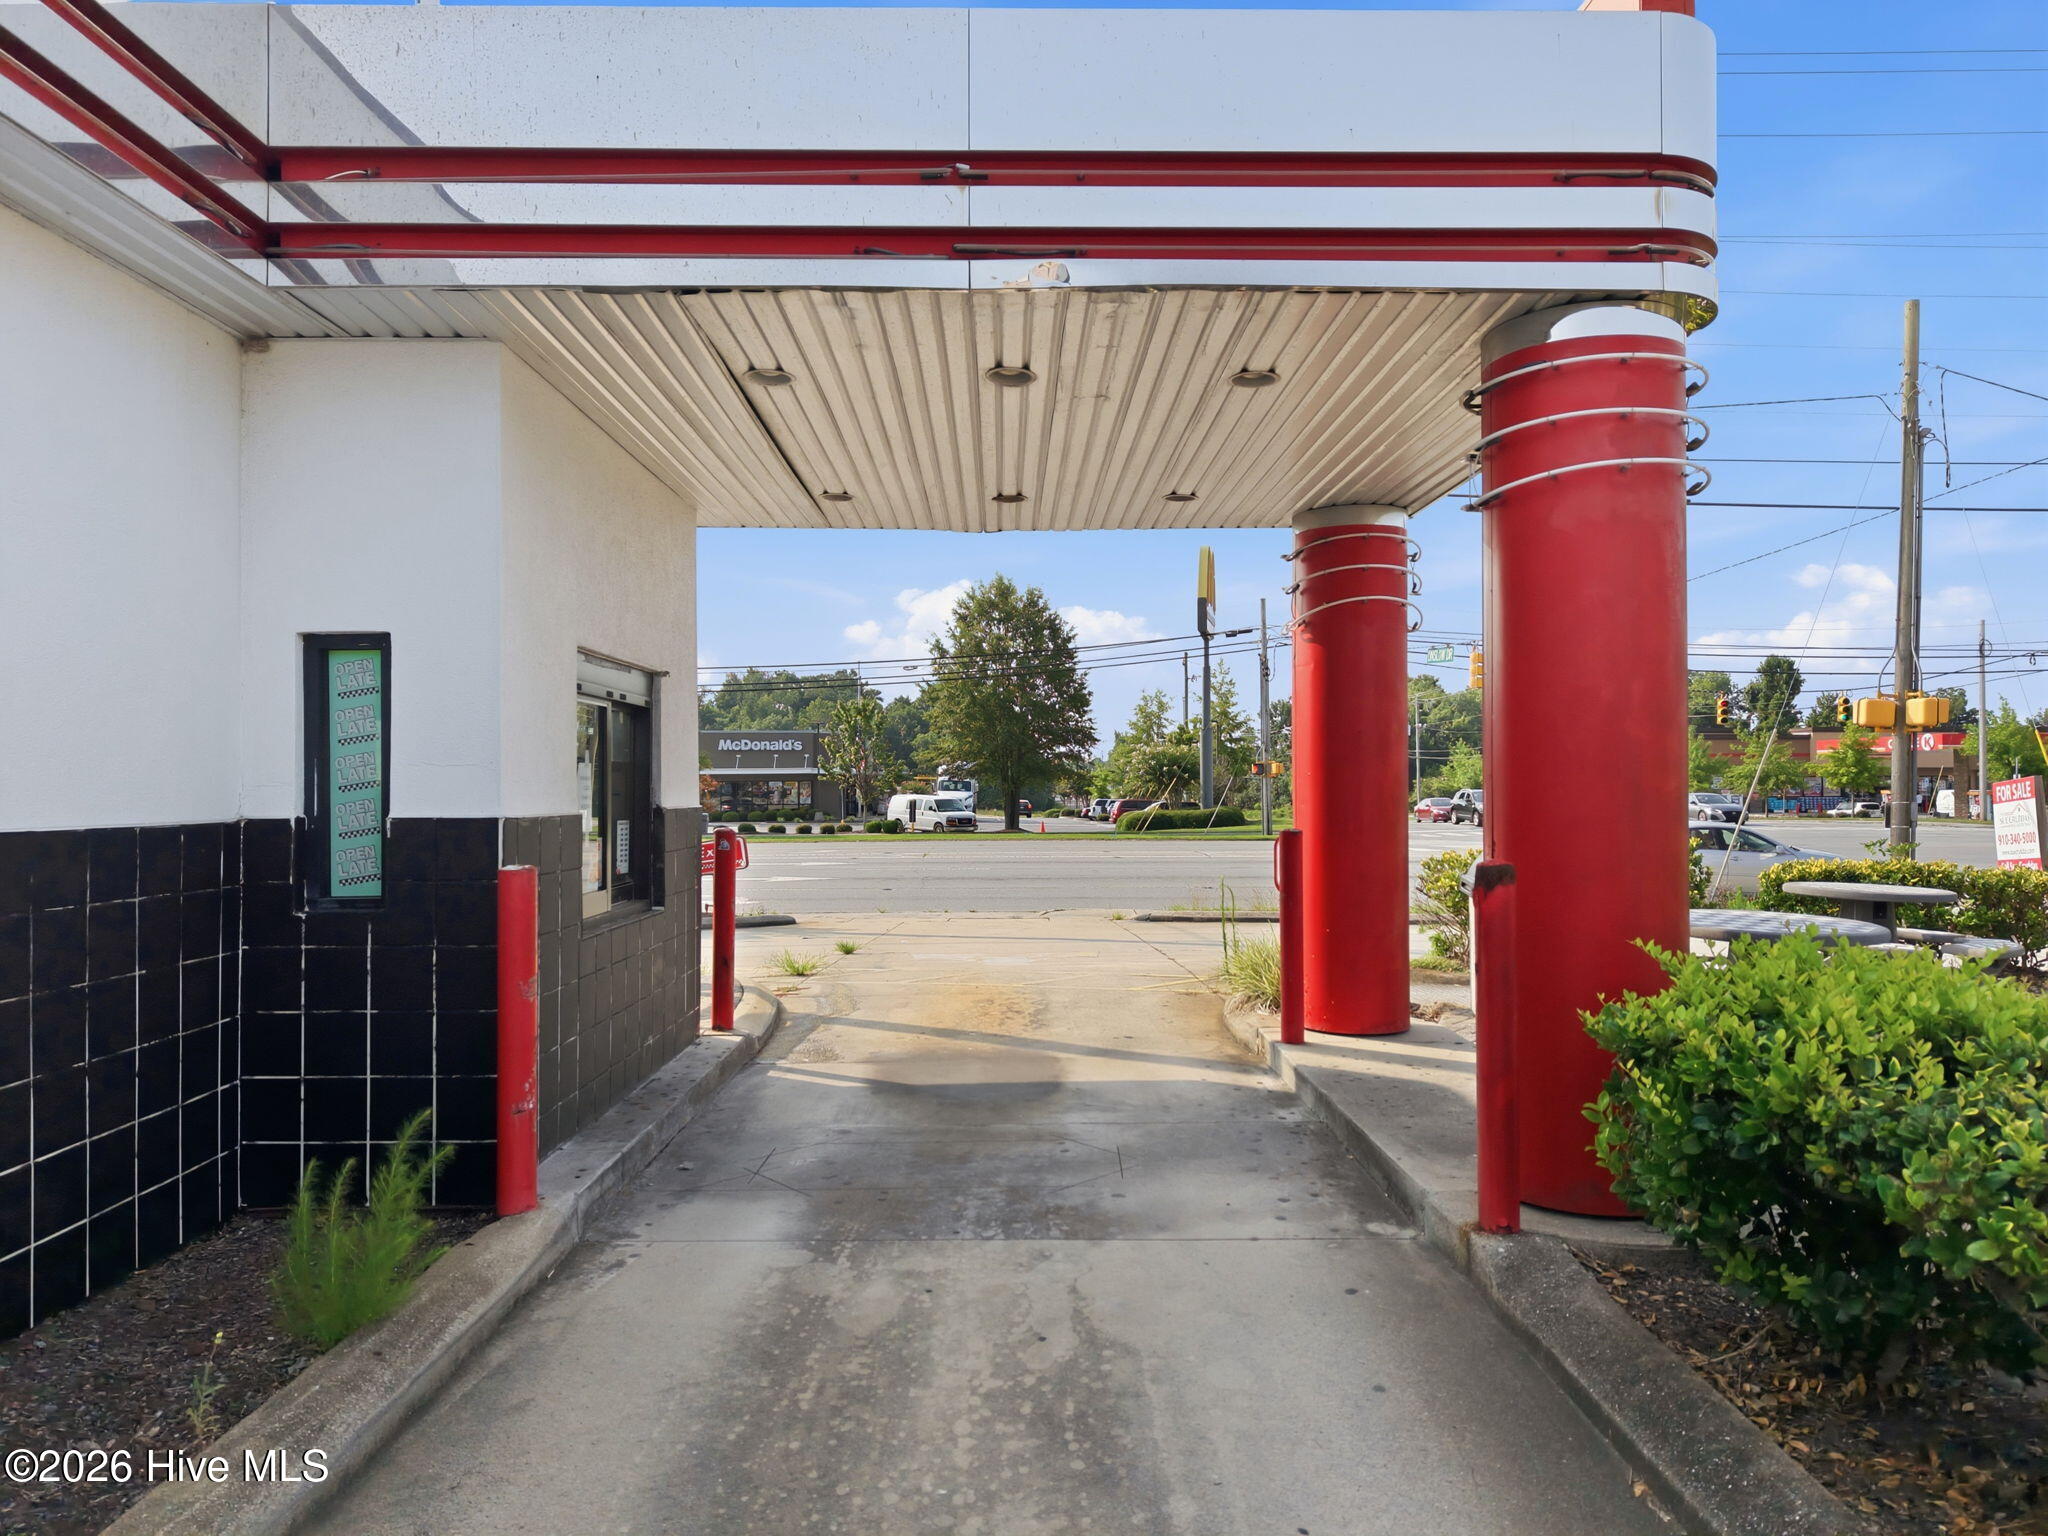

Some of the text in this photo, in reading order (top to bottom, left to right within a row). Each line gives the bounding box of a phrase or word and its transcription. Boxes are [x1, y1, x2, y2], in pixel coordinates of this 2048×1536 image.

[335, 658, 374, 675] OPEN
[336, 672, 376, 690] LATE
[335, 704, 375, 721] OPEN
[336, 717, 377, 737] LATE
[717, 738, 803, 751] McDonald's
[335, 752, 375, 768] OPEN
[337, 765, 377, 784] LATE
[1996, 781, 2032, 802] FOR SALE
[335, 798, 375, 815] OPEN
[336, 845, 375, 862] OPEN
